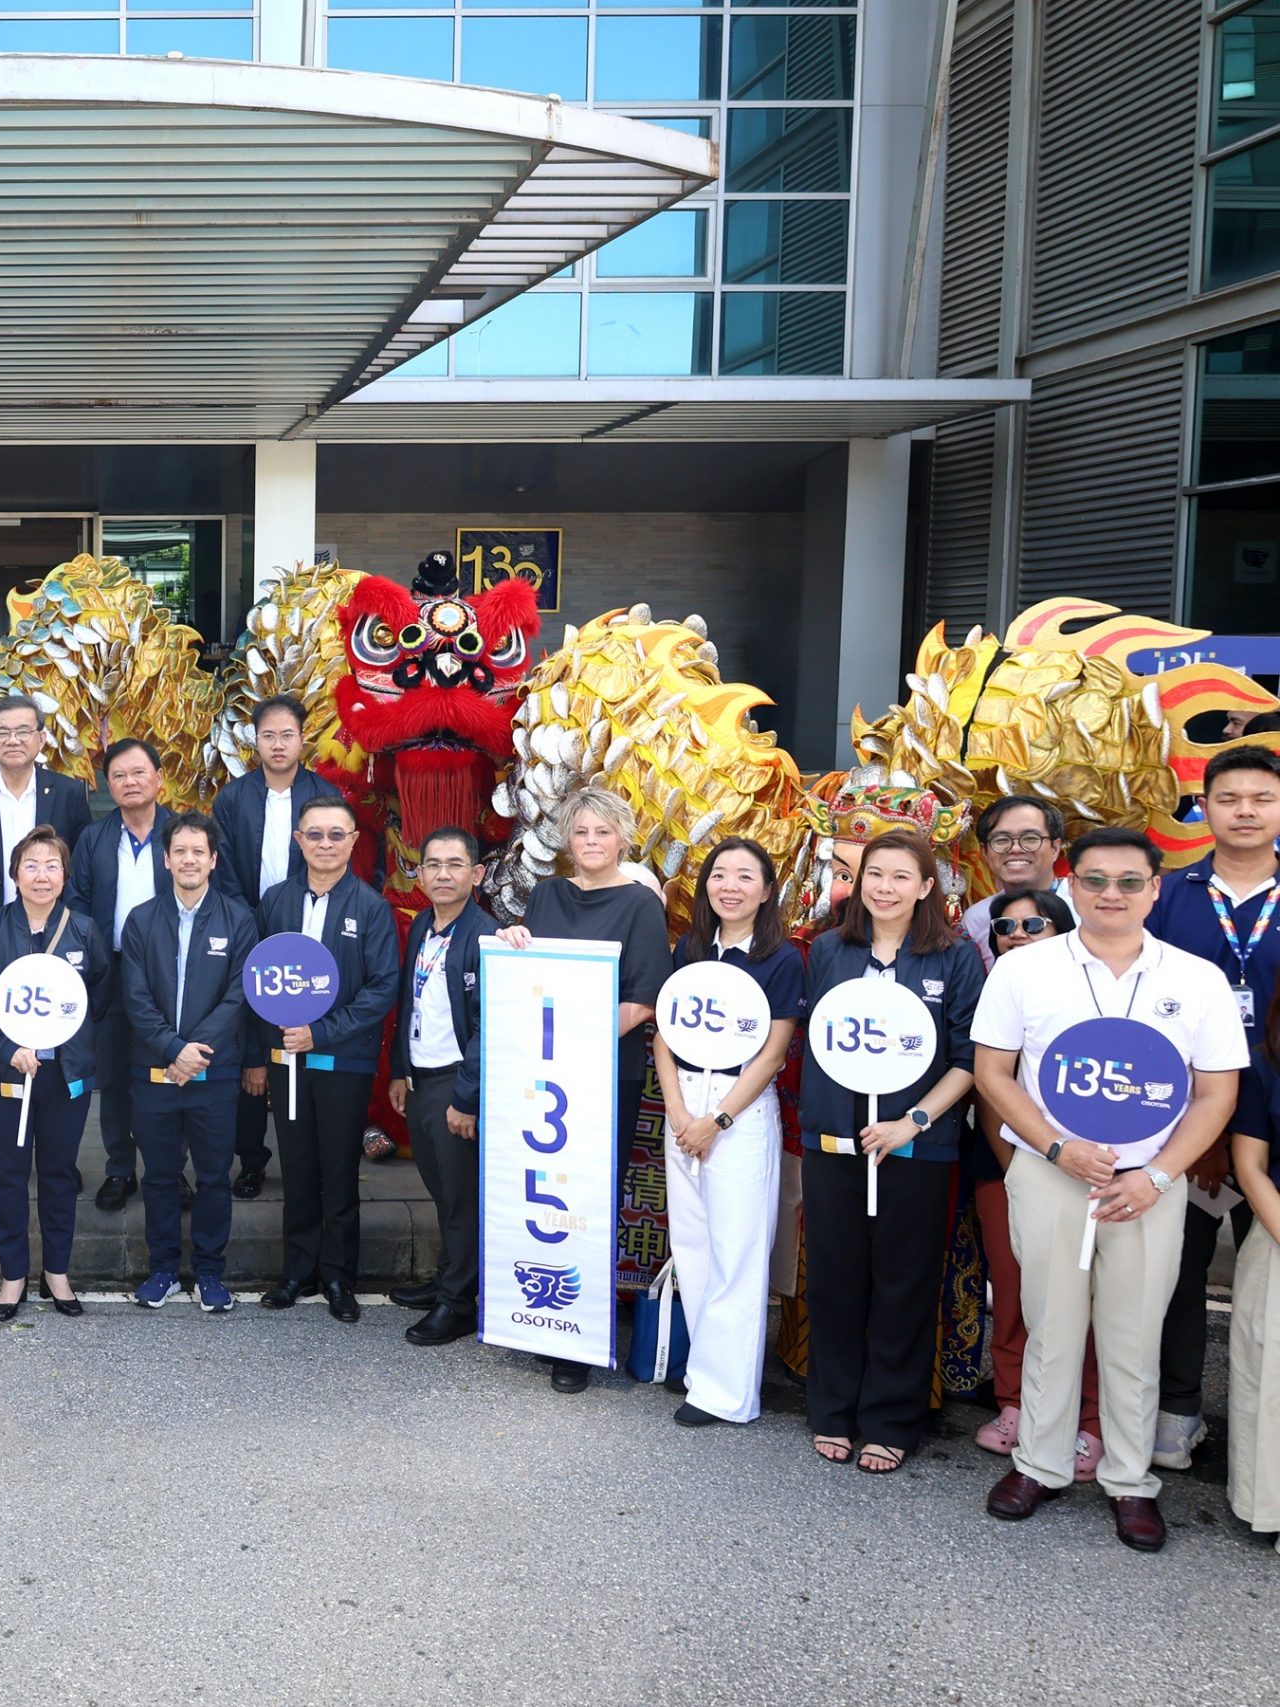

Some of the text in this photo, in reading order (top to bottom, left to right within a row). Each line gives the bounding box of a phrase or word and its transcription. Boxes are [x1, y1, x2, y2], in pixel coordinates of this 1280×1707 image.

[251, 964, 303, 996] 135
[4, 984, 53, 1017] 135
[670, 993, 727, 1032] 135
[821, 1015, 887, 1054] 135
[1055, 1053, 1133, 1102] 135
[1113, 1083, 1142, 1095] YEARS
[544, 1210, 588, 1232] YEARS
[511, 1311, 581, 1335] OSOTSPA
